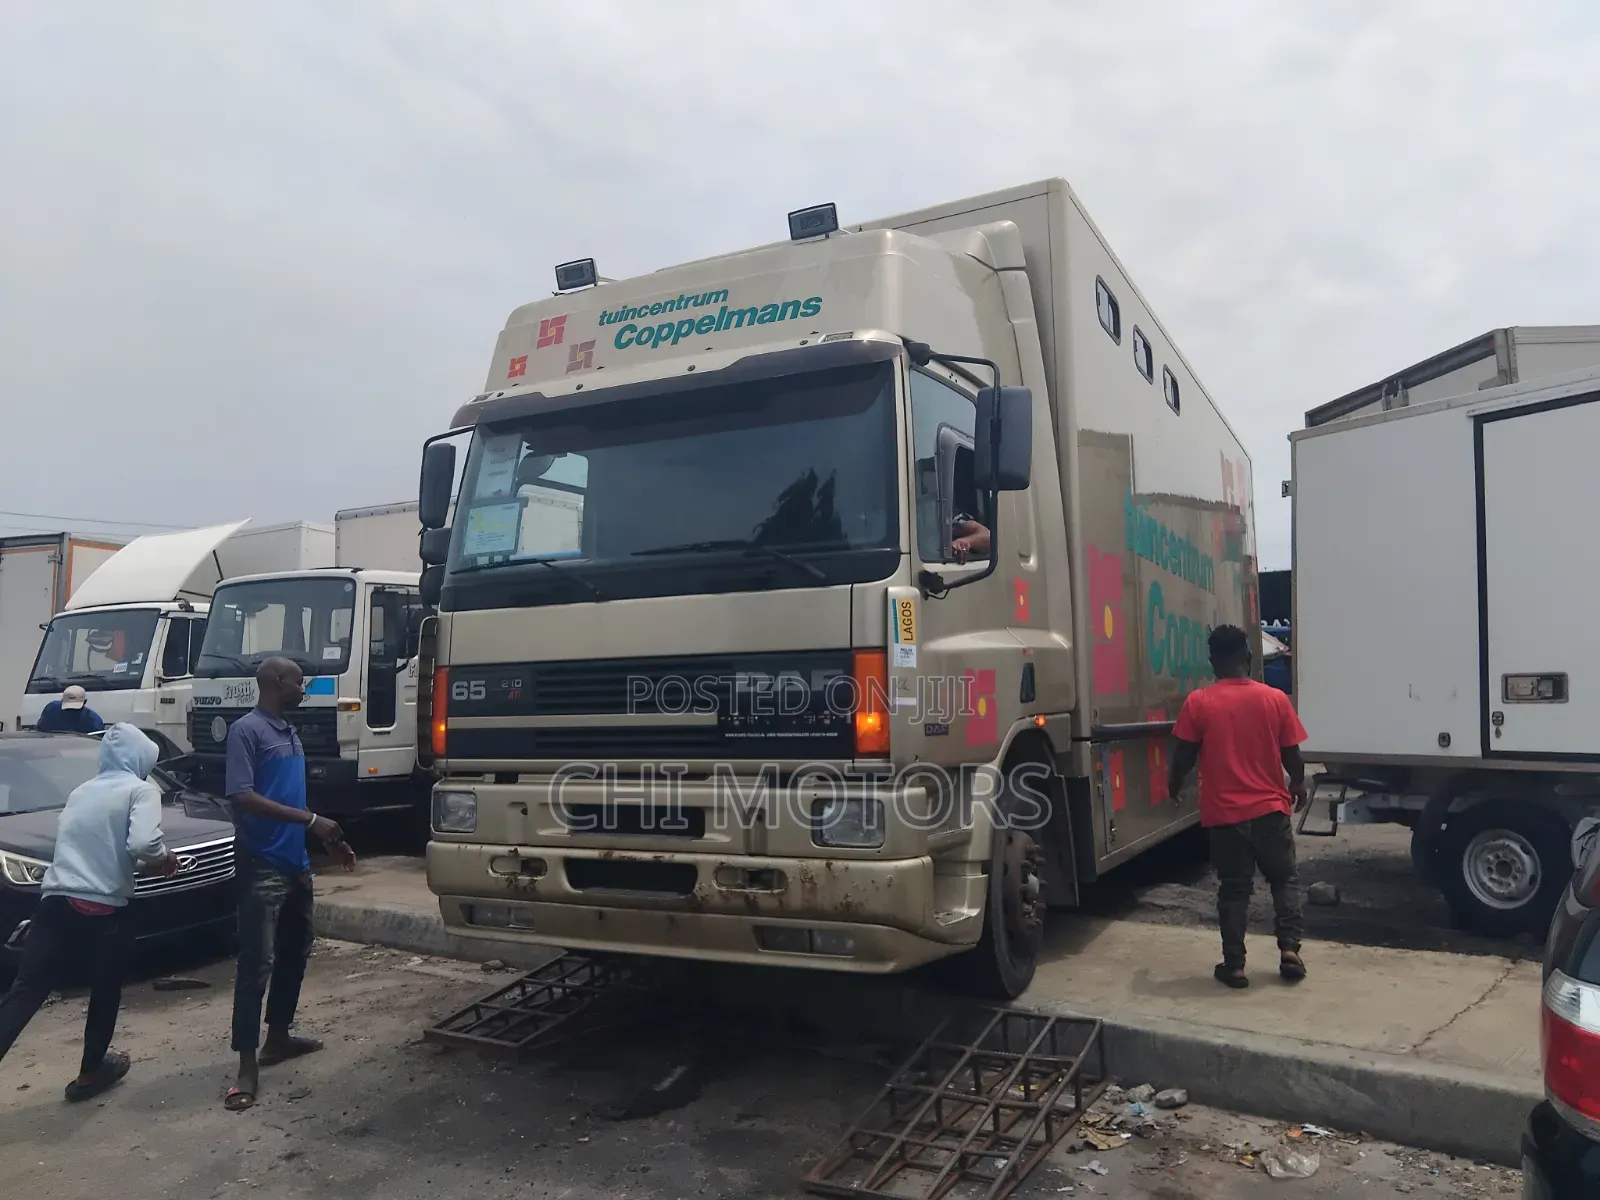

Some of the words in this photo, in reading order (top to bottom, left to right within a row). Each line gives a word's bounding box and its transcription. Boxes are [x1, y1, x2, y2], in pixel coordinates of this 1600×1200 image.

[598, 288, 729, 326] tuincentrum
[613, 295, 823, 350] Coppelmans
[901, 601, 914, 641] LAGOS
[193, 696, 222, 705] VOLVO
[452, 680, 486, 700] 65
